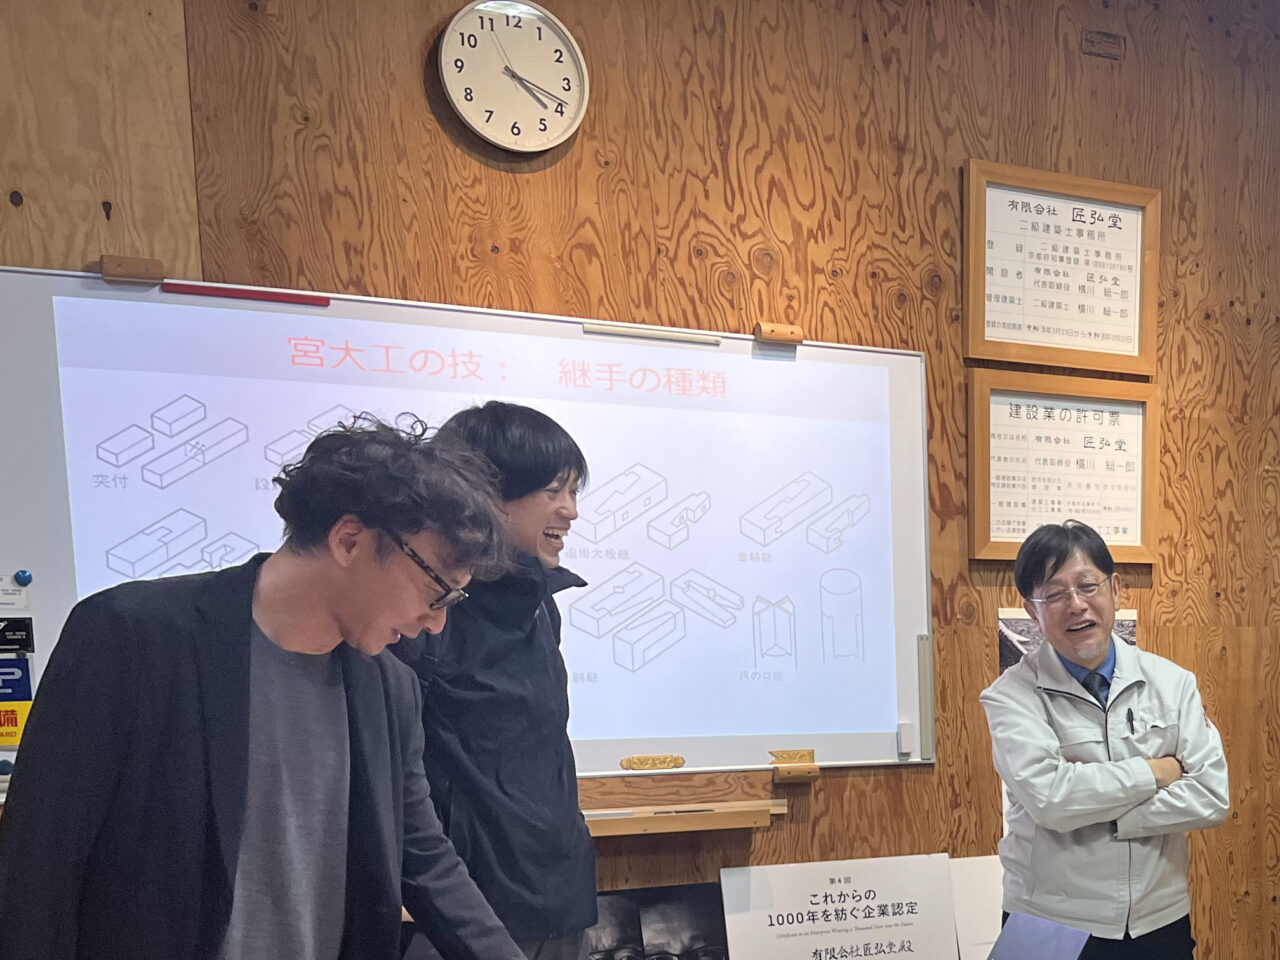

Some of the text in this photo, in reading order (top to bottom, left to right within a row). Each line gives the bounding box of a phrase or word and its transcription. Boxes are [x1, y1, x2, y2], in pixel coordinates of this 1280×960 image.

[478, 15, 494, 32] 11
[505, 15, 523, 29] 12
[459, 32, 478, 48] 10
[536, 26, 542, 41] 1
[553, 48, 564, 63] 2
[454, 58, 465, 74] 9
[561, 77, 572, 92] 3
[463, 87, 474, 102] 8
[484, 109, 494, 123] 7
[554, 102, 565, 117] 4
[510, 121, 521, 136] 6
[538, 118, 548, 132] 5
[1007, 200, 1123, 230] 有限会社 匠弘堂
[1020, 220, 1106, 242] 二級建築士事務所
[1086, 272, 1121, 287] 匠弘堂
[558, 357, 728, 399] 継手の種類
[1008, 402, 1121, 427] 建設業の許可票
[1083, 436, 1127, 452] 匠弘堂
[809, 888, 877, 906] これからの
[767, 901, 919, 927] 1000年を紡ぐ企業認定
